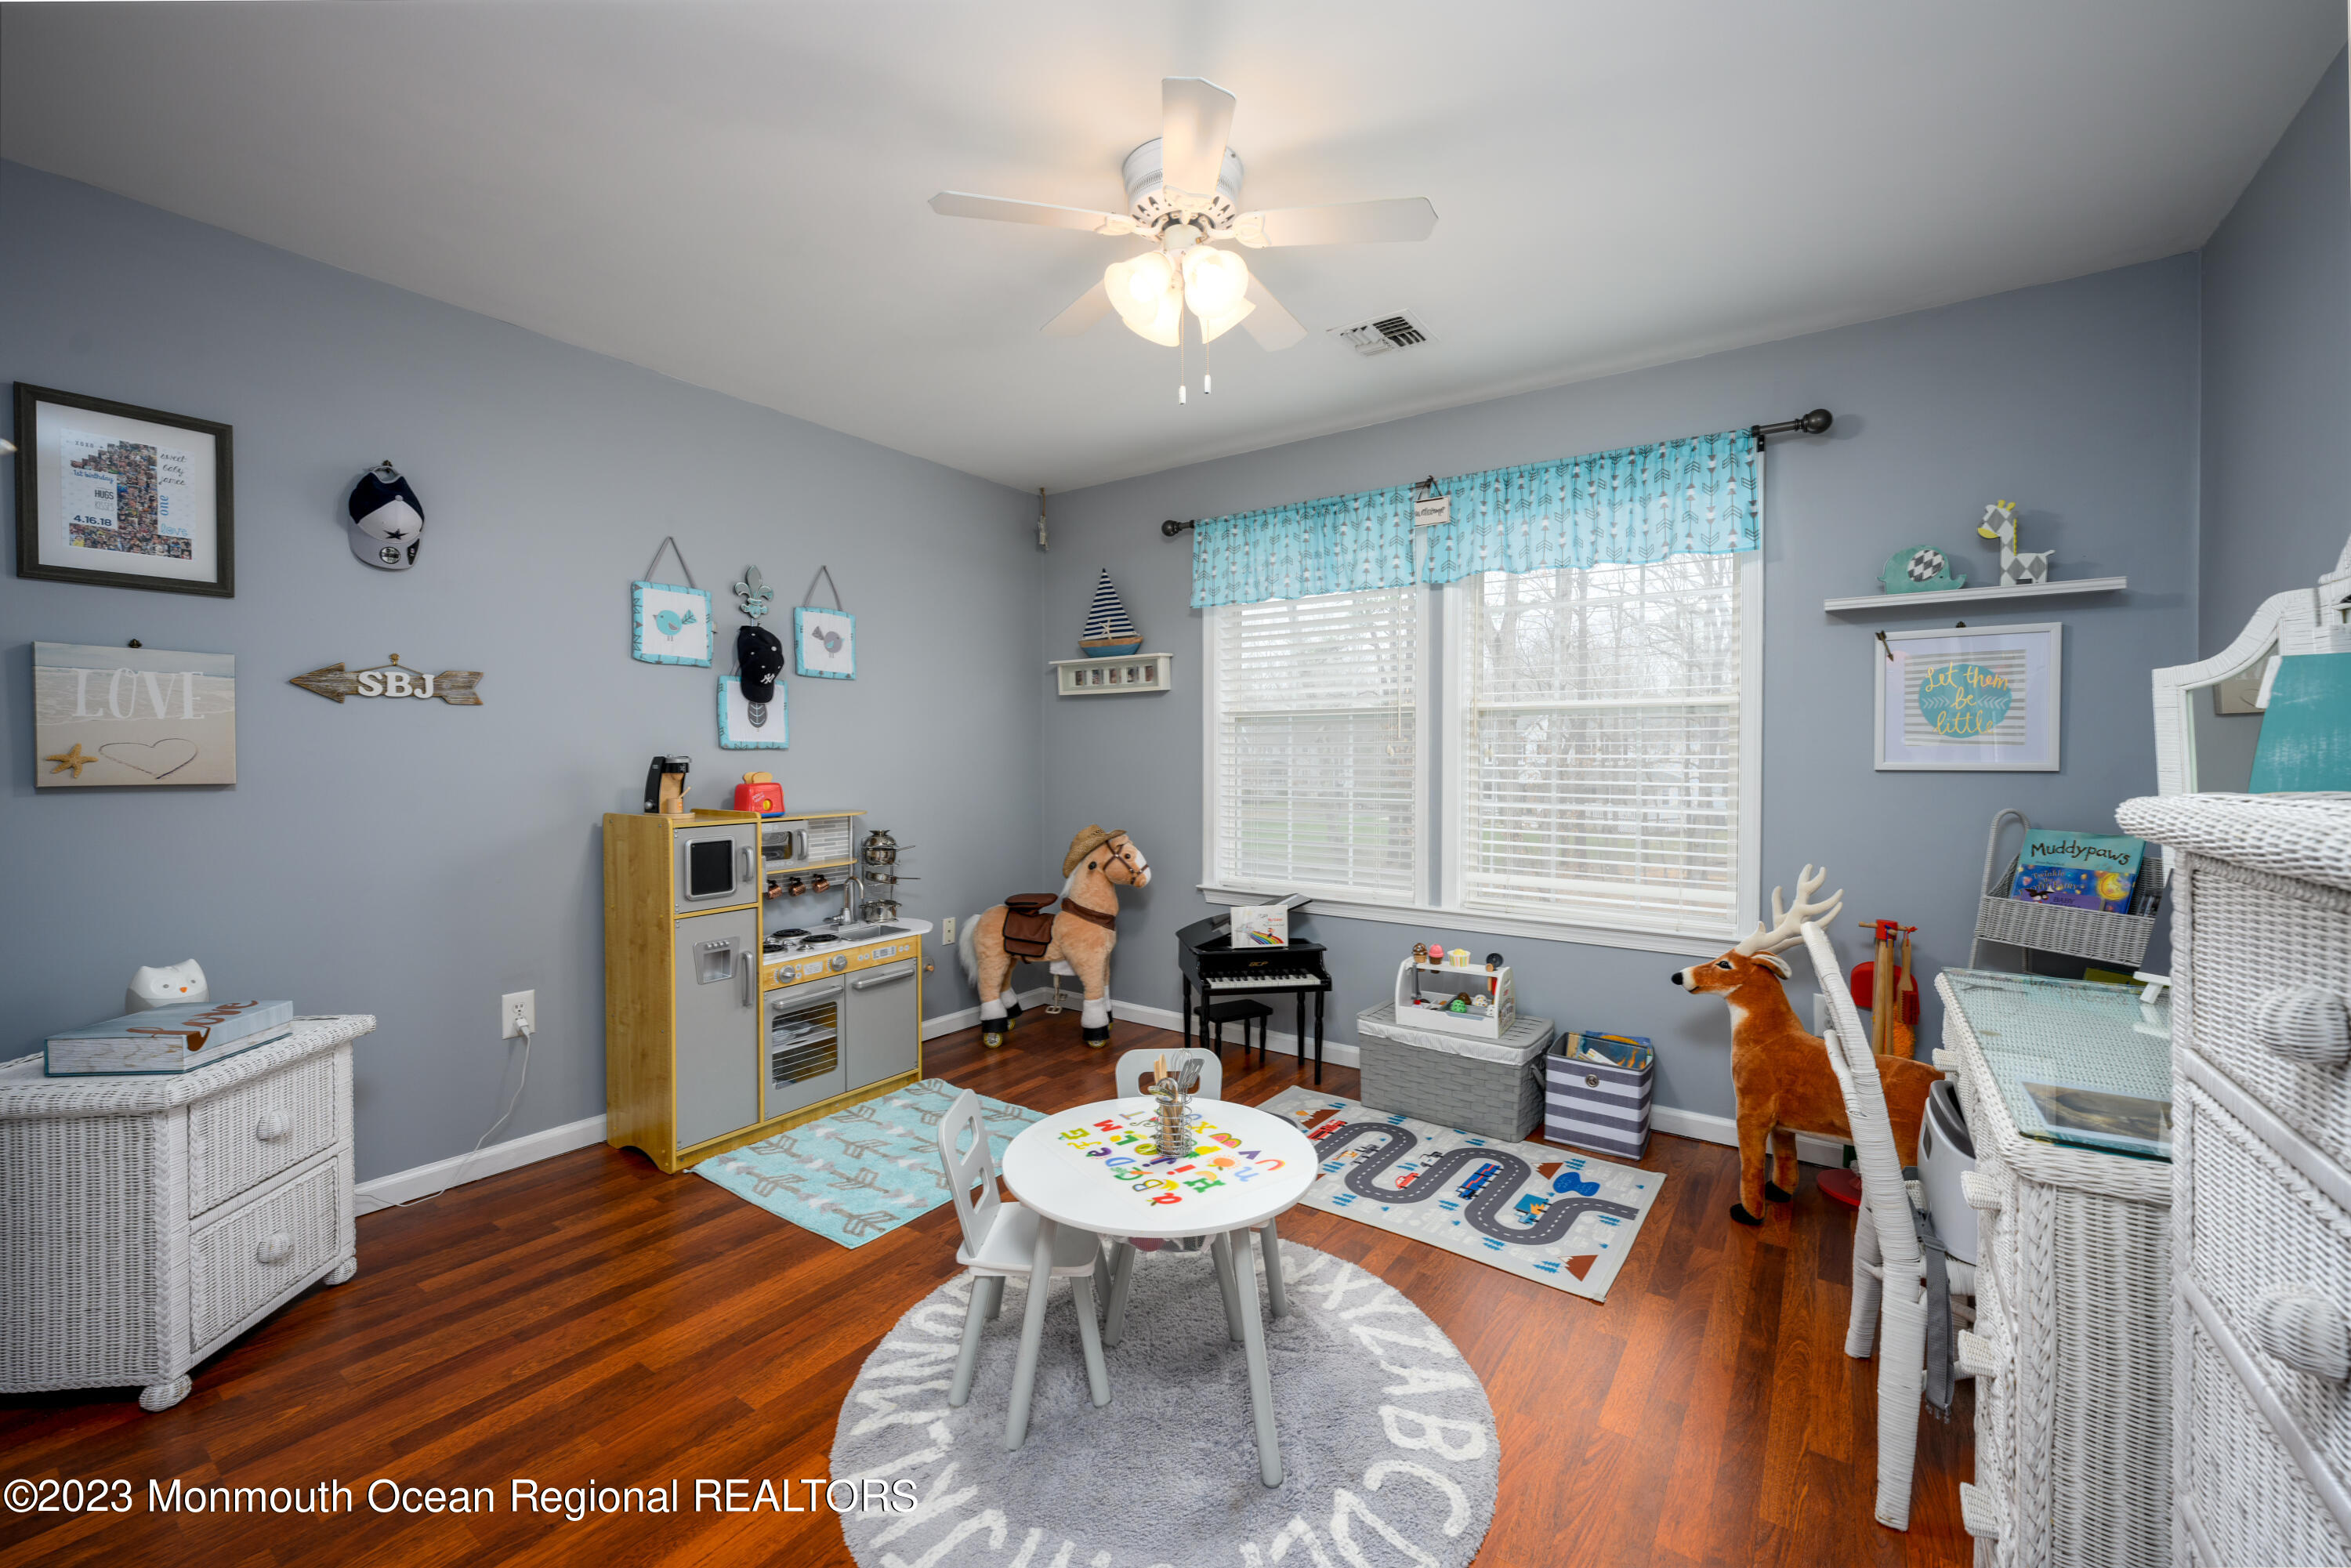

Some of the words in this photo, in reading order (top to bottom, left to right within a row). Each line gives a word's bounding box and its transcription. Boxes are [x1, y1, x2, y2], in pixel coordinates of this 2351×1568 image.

[85, 471, 114, 484] birthday
[94, 489, 114, 500] HUGS
[160, 494, 169, 516] one
[74, 515, 112, 527] 4.16.18
[357, 671, 436, 699] SBJ
[1925, 661, 1958, 693] Let
[1962, 665, 2009, 691] them
[71, 667, 205, 719] LOVE
[1951, 686, 1977, 710] be
[1933, 709, 1995, 736] little
[2030, 838, 2132, 866] Muddypaws
[1379, 1359, 1478, 1396] A
[1378, 1404, 1489, 1461] B
[1364, 1458, 1473, 1538] C
